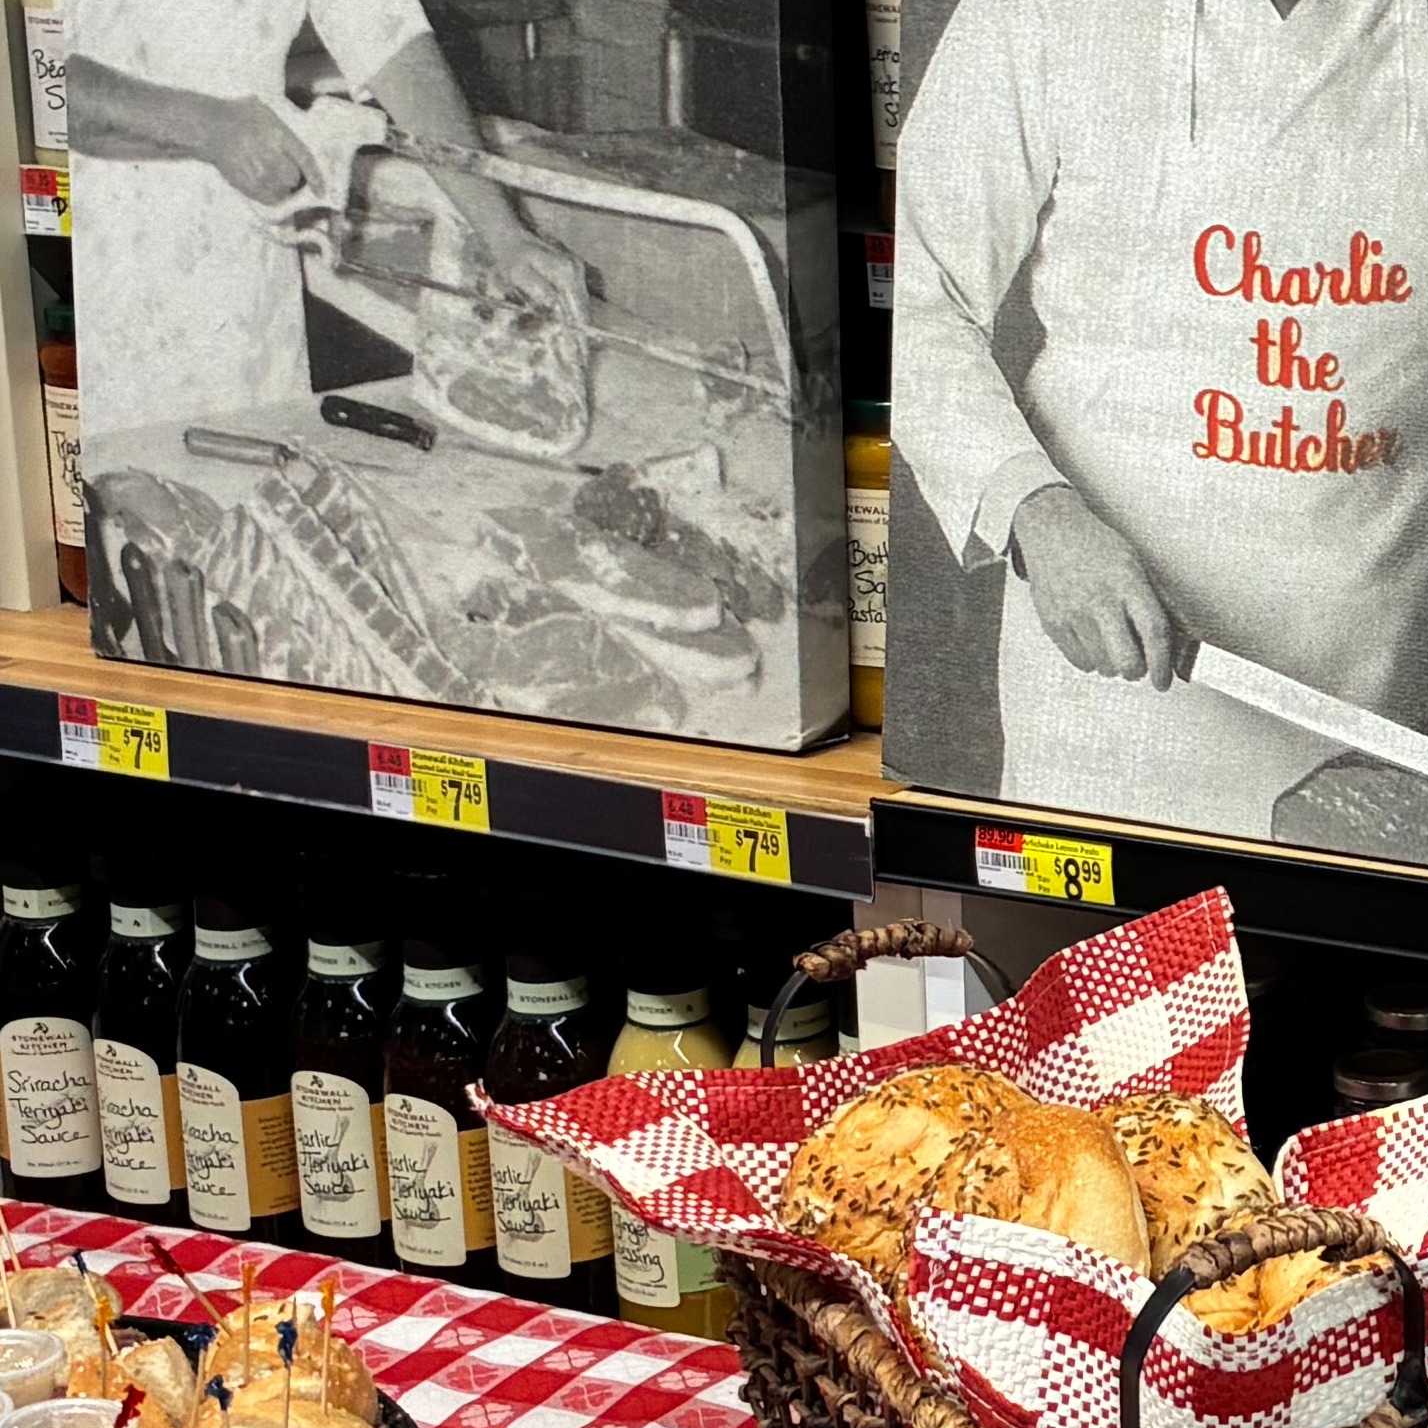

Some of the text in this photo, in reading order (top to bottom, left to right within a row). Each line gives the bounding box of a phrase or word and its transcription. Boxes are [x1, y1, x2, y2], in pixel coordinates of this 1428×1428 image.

[1193, 224, 1413, 306] Charlie
[1249, 316, 1344, 392] the
[1192, 388, 1401, 474] Butcher
[8, 1070, 91, 1094] Sriracha
[9, 1096, 89, 1129] Teriyaki
[21, 1125, 90, 1146] Sauce
